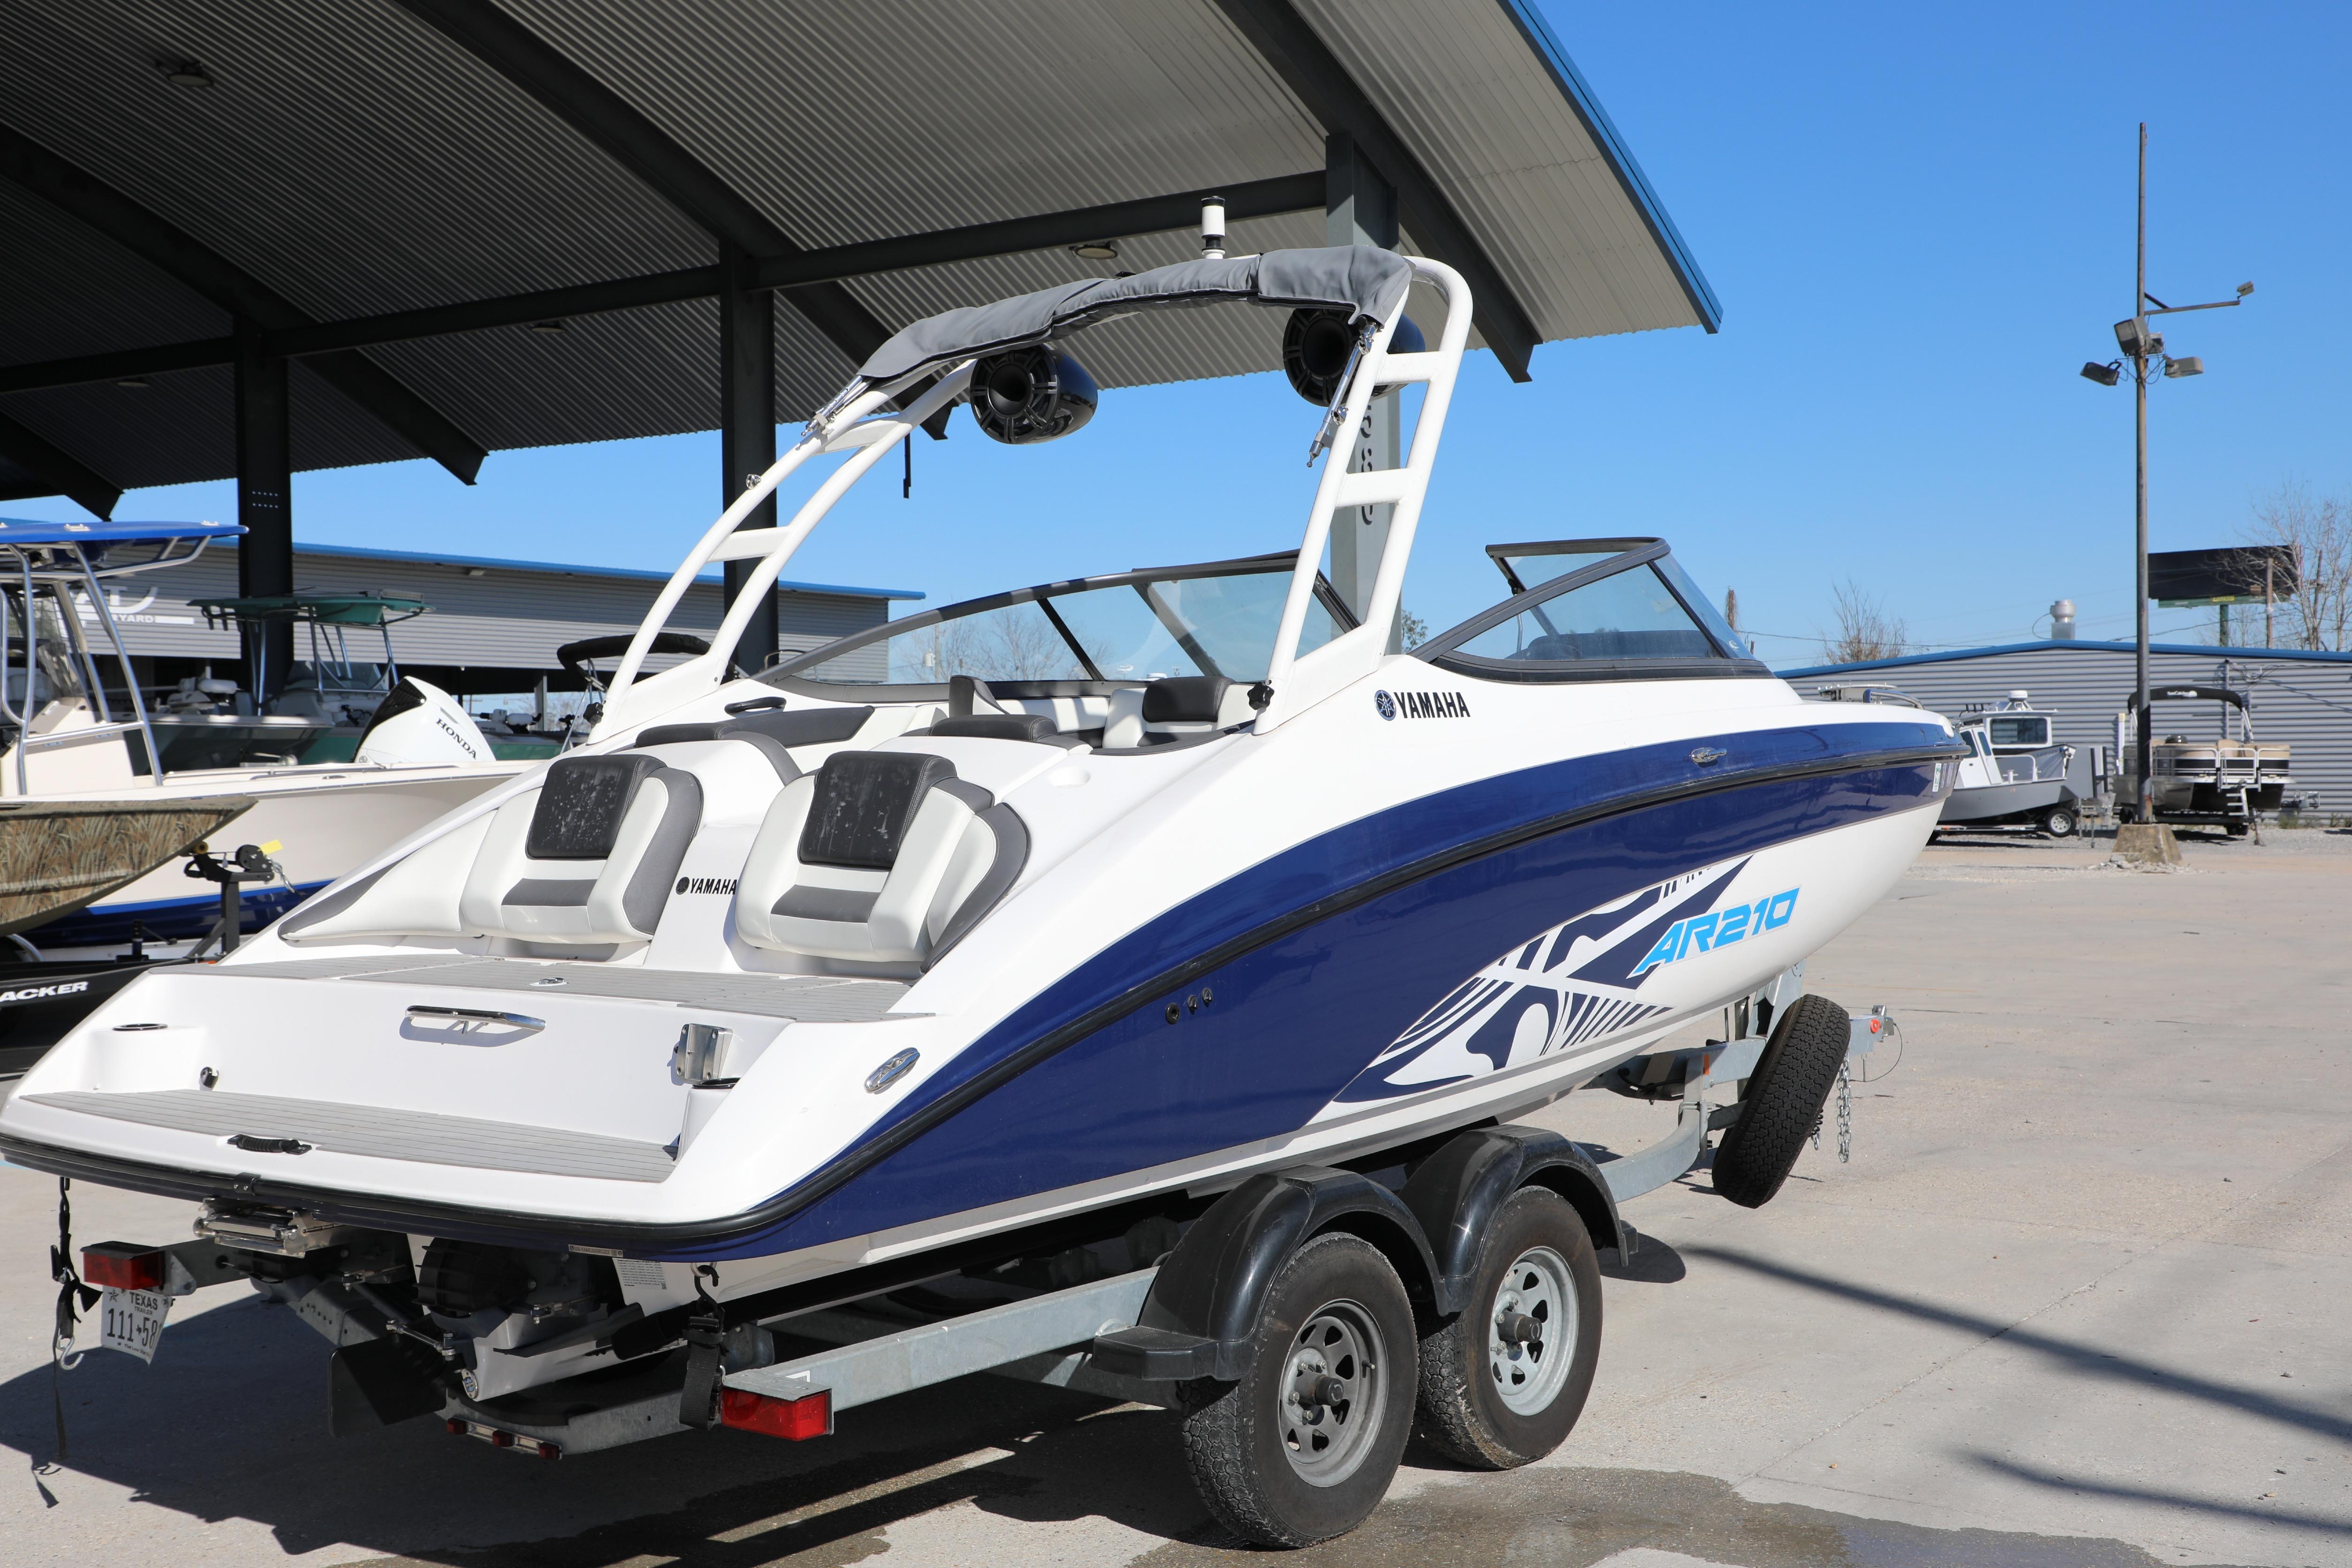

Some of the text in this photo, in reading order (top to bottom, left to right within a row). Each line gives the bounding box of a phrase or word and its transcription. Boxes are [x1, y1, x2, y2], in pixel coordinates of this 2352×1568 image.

[1393, 692, 1470, 718] YAMAHA
[436, 718, 476, 760] HONDA
[690, 878, 738, 895] YAMAHA
[1632, 887, 1800, 974] AR210
[129, 1291, 158, 1311] TEXAS
[134, 1306, 152, 1316] TRAILER
[107, 1308, 133, 1342] 111
